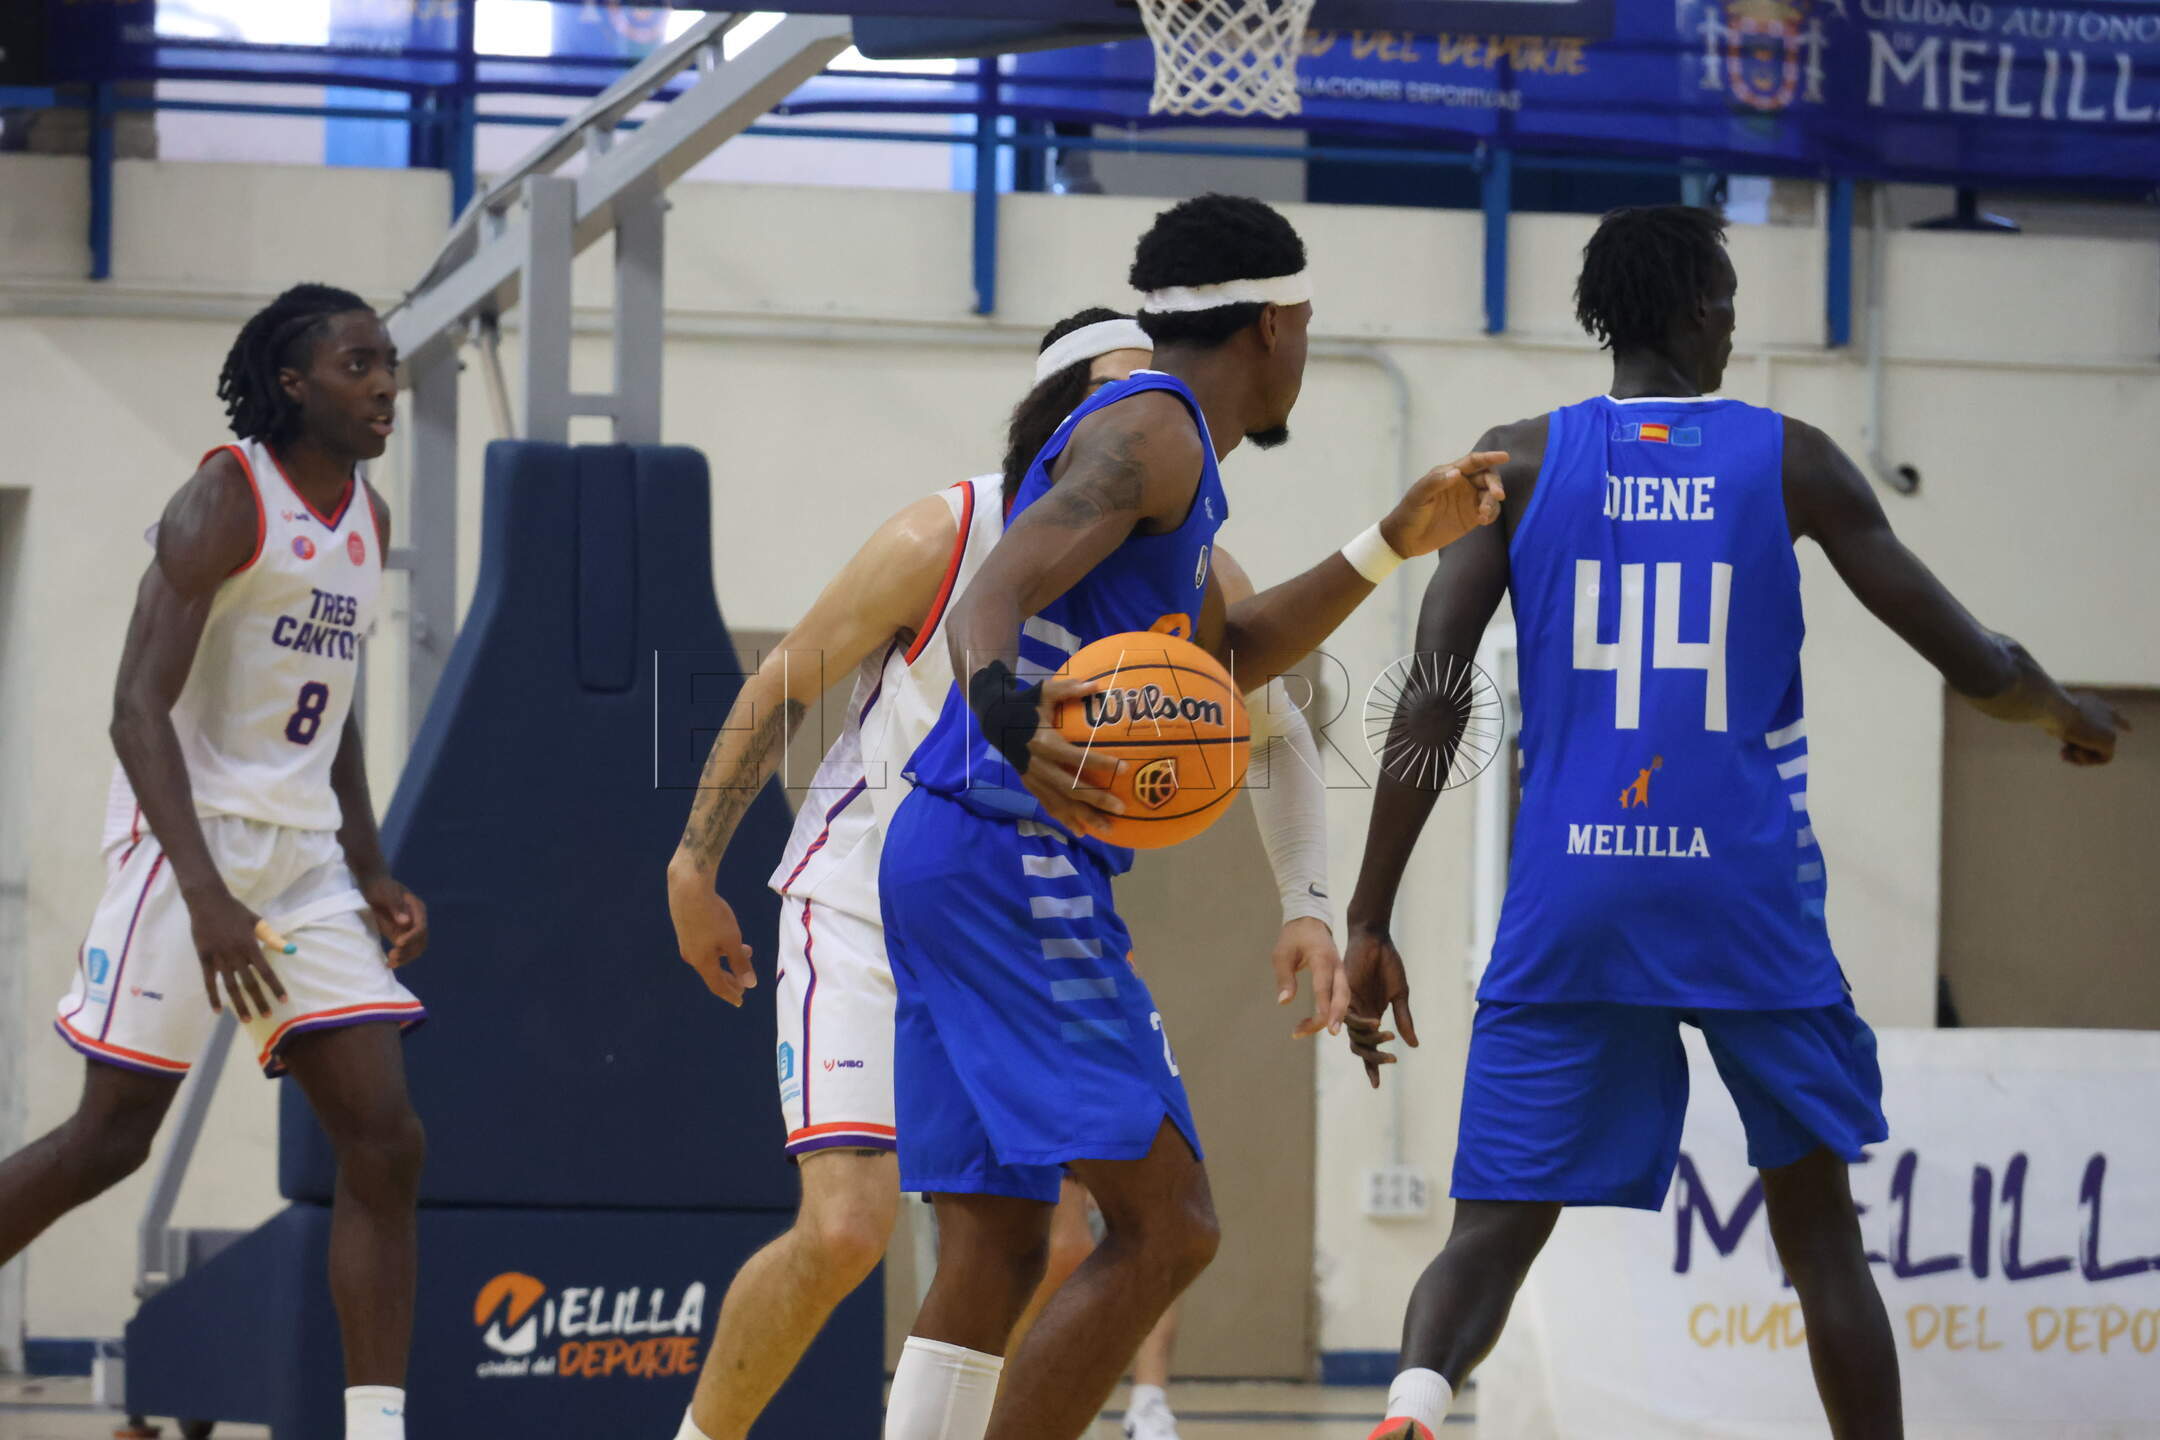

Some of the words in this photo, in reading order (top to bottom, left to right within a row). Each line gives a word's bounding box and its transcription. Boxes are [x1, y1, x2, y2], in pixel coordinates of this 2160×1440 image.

[1867, 29, 2160, 122] MELILL
[1603, 470, 1716, 522] DIENE
[309, 587, 358, 627] TRES
[272, 614, 364, 661] CANTO
[1572, 558, 1733, 732] 44
[284, 680, 329, 745] 8
[1082, 683, 1225, 728] Wilson
[1566, 823, 1711, 858] MELILLA
[1905, 1303, 2002, 1350] DEL
[558, 1336, 698, 1378] DEPORTE
